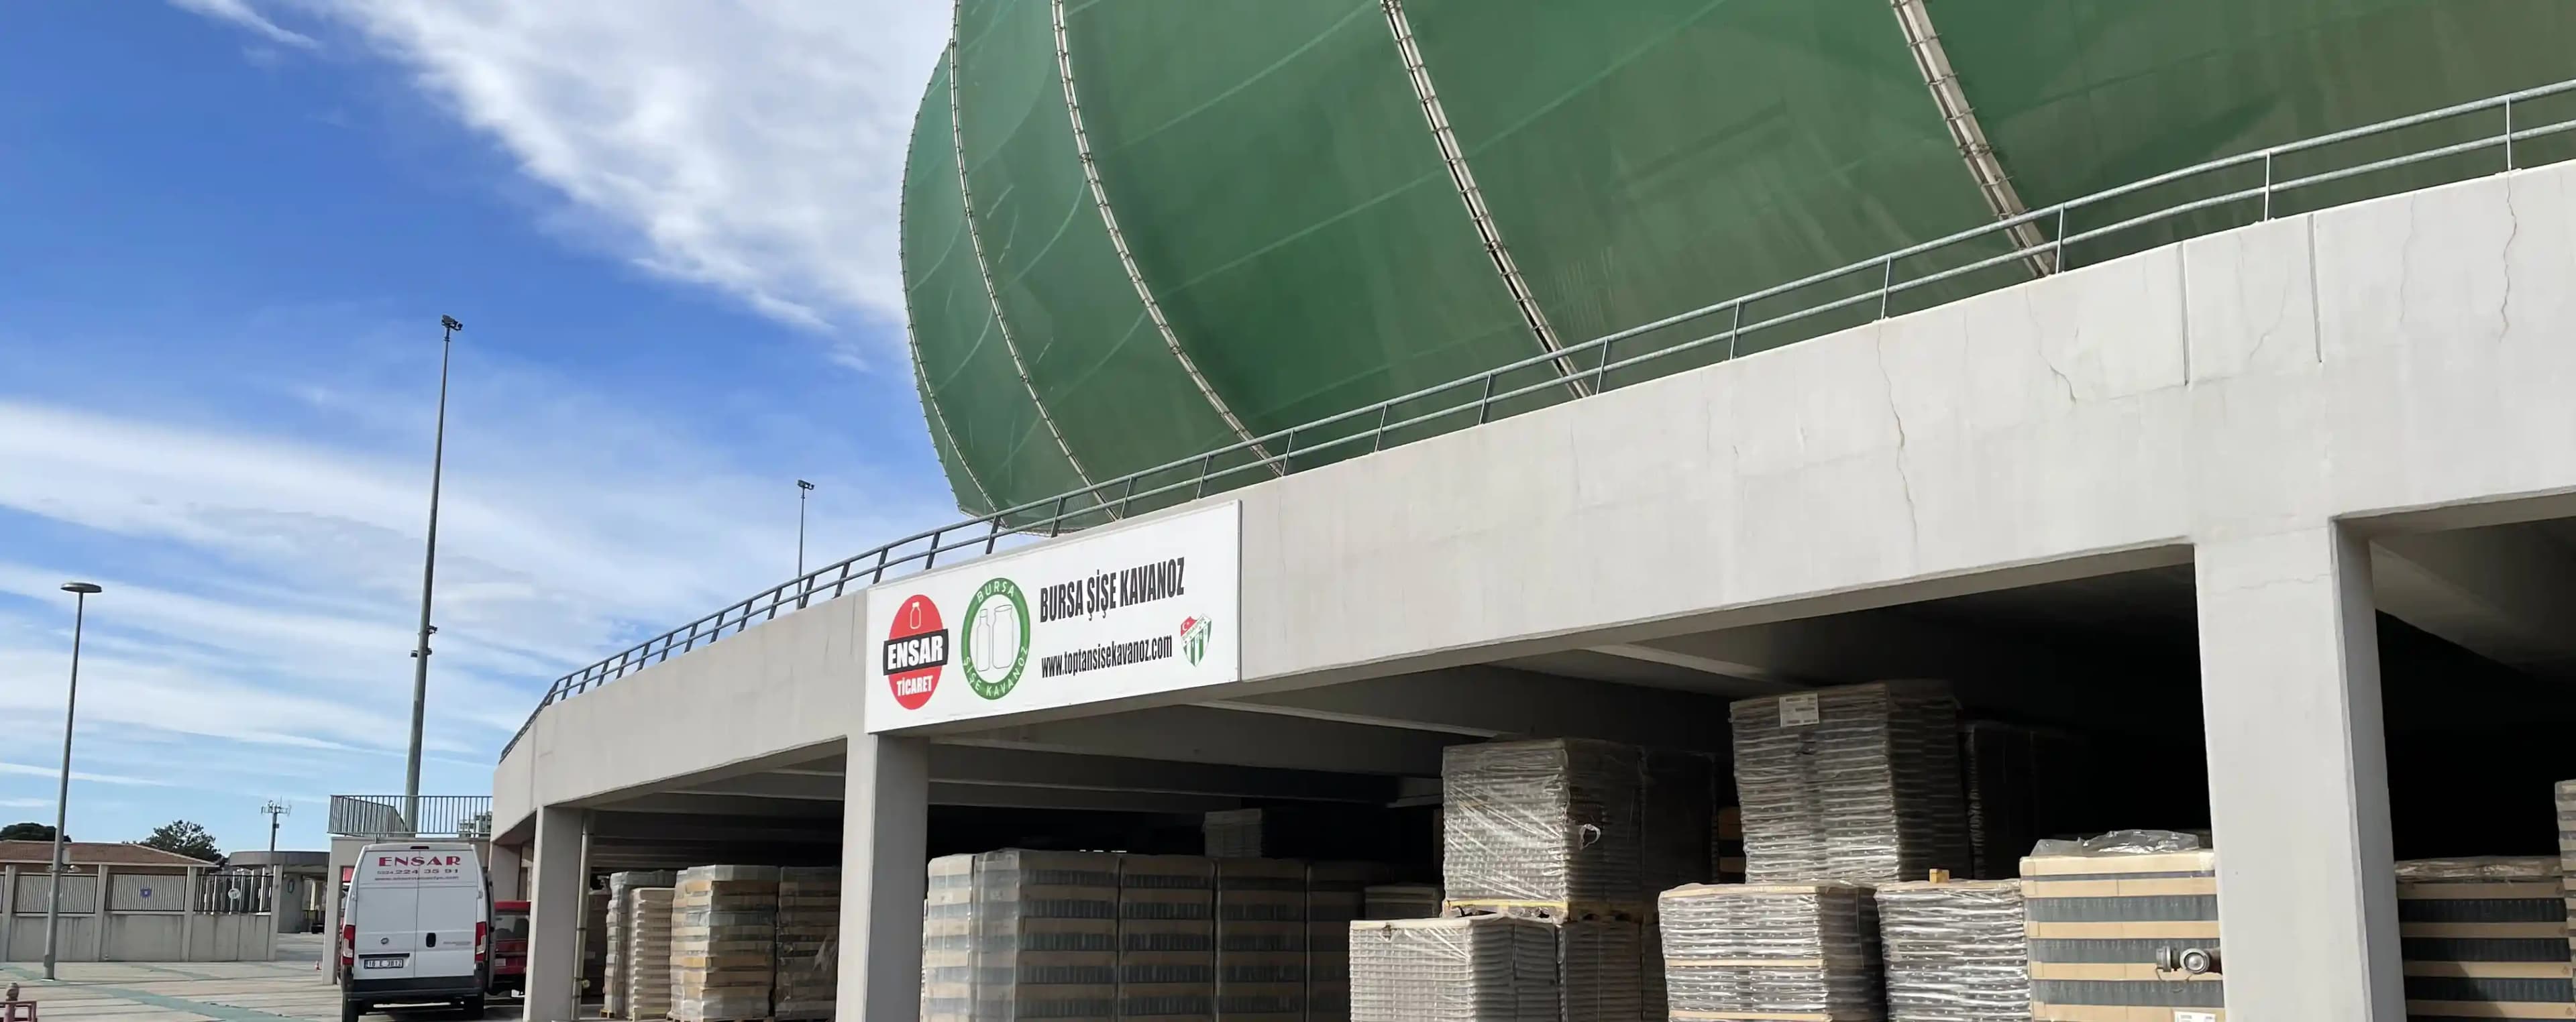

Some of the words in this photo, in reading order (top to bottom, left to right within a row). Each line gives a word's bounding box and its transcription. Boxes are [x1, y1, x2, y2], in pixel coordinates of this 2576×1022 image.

[977, 581, 1015, 603] BURSA
[1040, 579, 1084, 623] BURSA
[1087, 569, 1117, 622] ŞİŞE
[1120, 557, 1185, 608] KAVANOZ
[888, 635, 943, 670] ENSAR
[1041, 634, 1173, 679] www.toptansisekavanoz.com
[896, 675, 933, 697] TİCARET
[986, 647, 1028, 697] KAVANOZ
[378, 856, 461, 866] ENSAR
